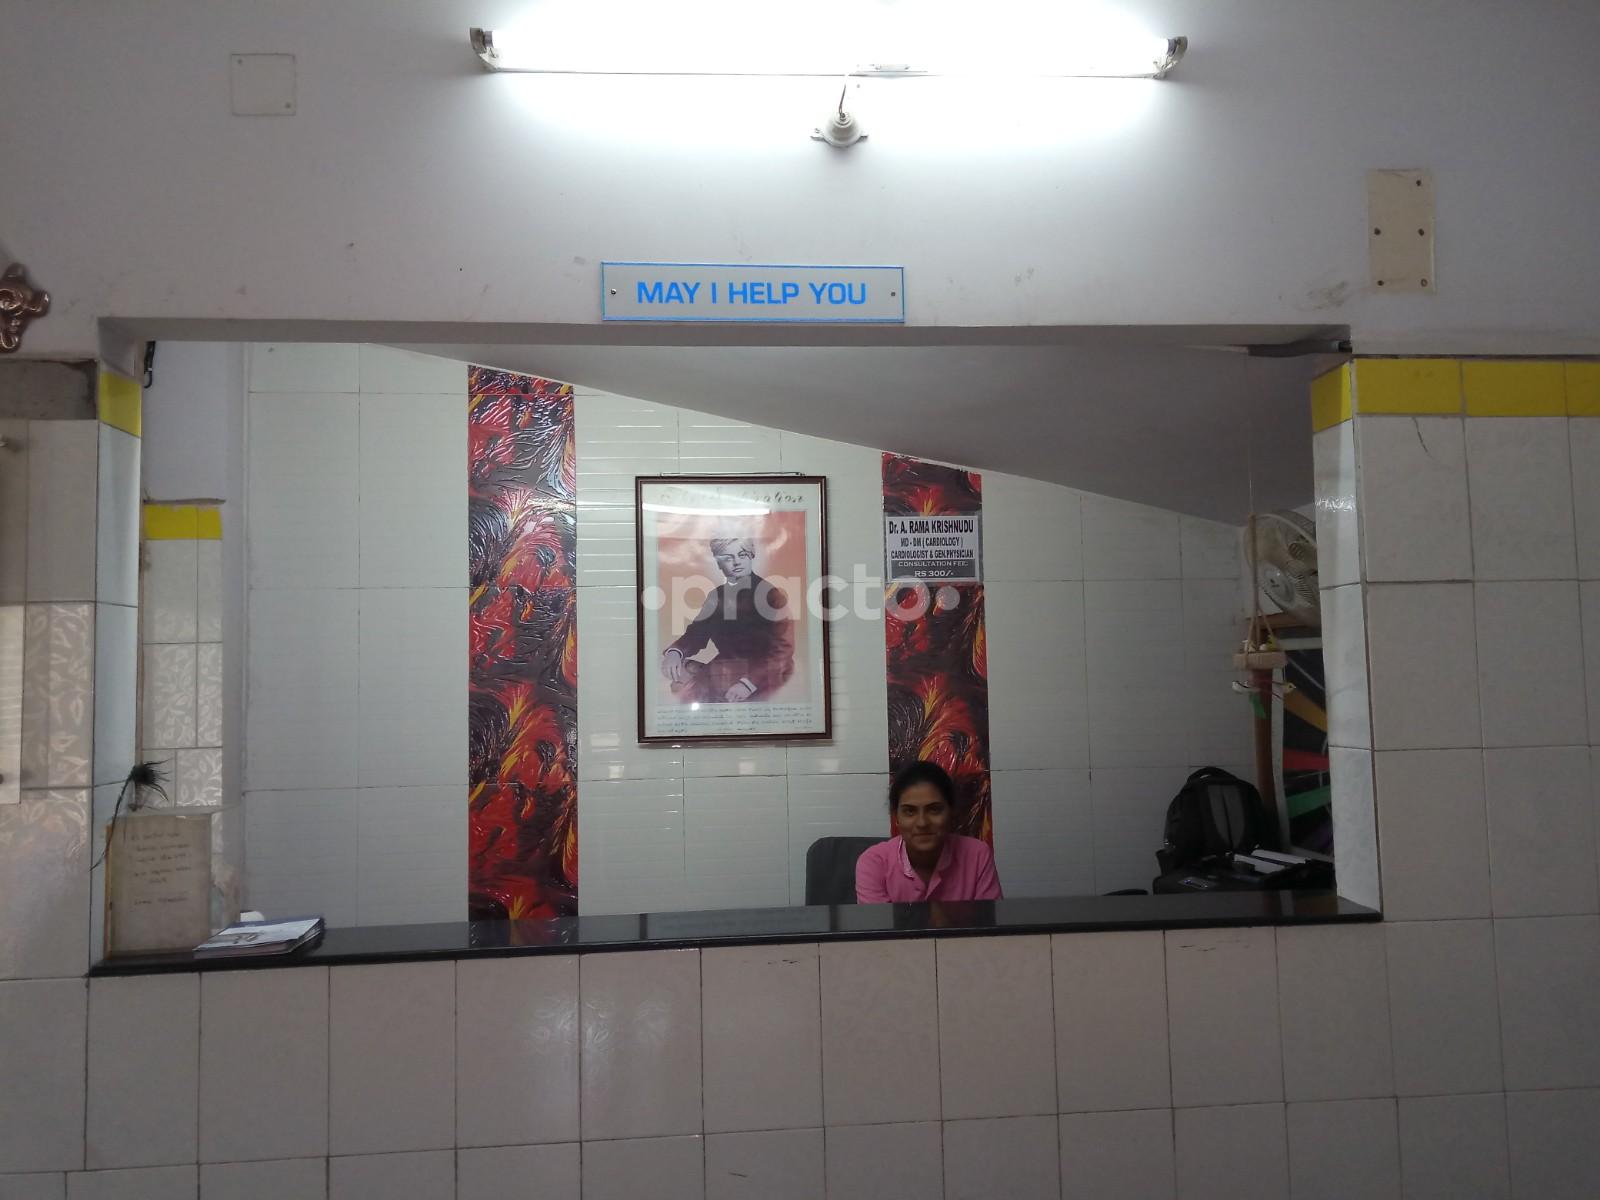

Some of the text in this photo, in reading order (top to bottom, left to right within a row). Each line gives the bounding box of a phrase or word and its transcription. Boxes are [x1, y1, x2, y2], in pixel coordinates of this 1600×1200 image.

[637, 281, 866, 305] MAY I HELP YOU
[889, 519, 974, 534] Dr. A. RAMA KRISHNUDU
[900, 537, 909, 547] MD
[890, 550, 928, 559] CARDIOLOGIST
[930, 550, 933, 558] &
[928, 569, 954, 577] 300/-
